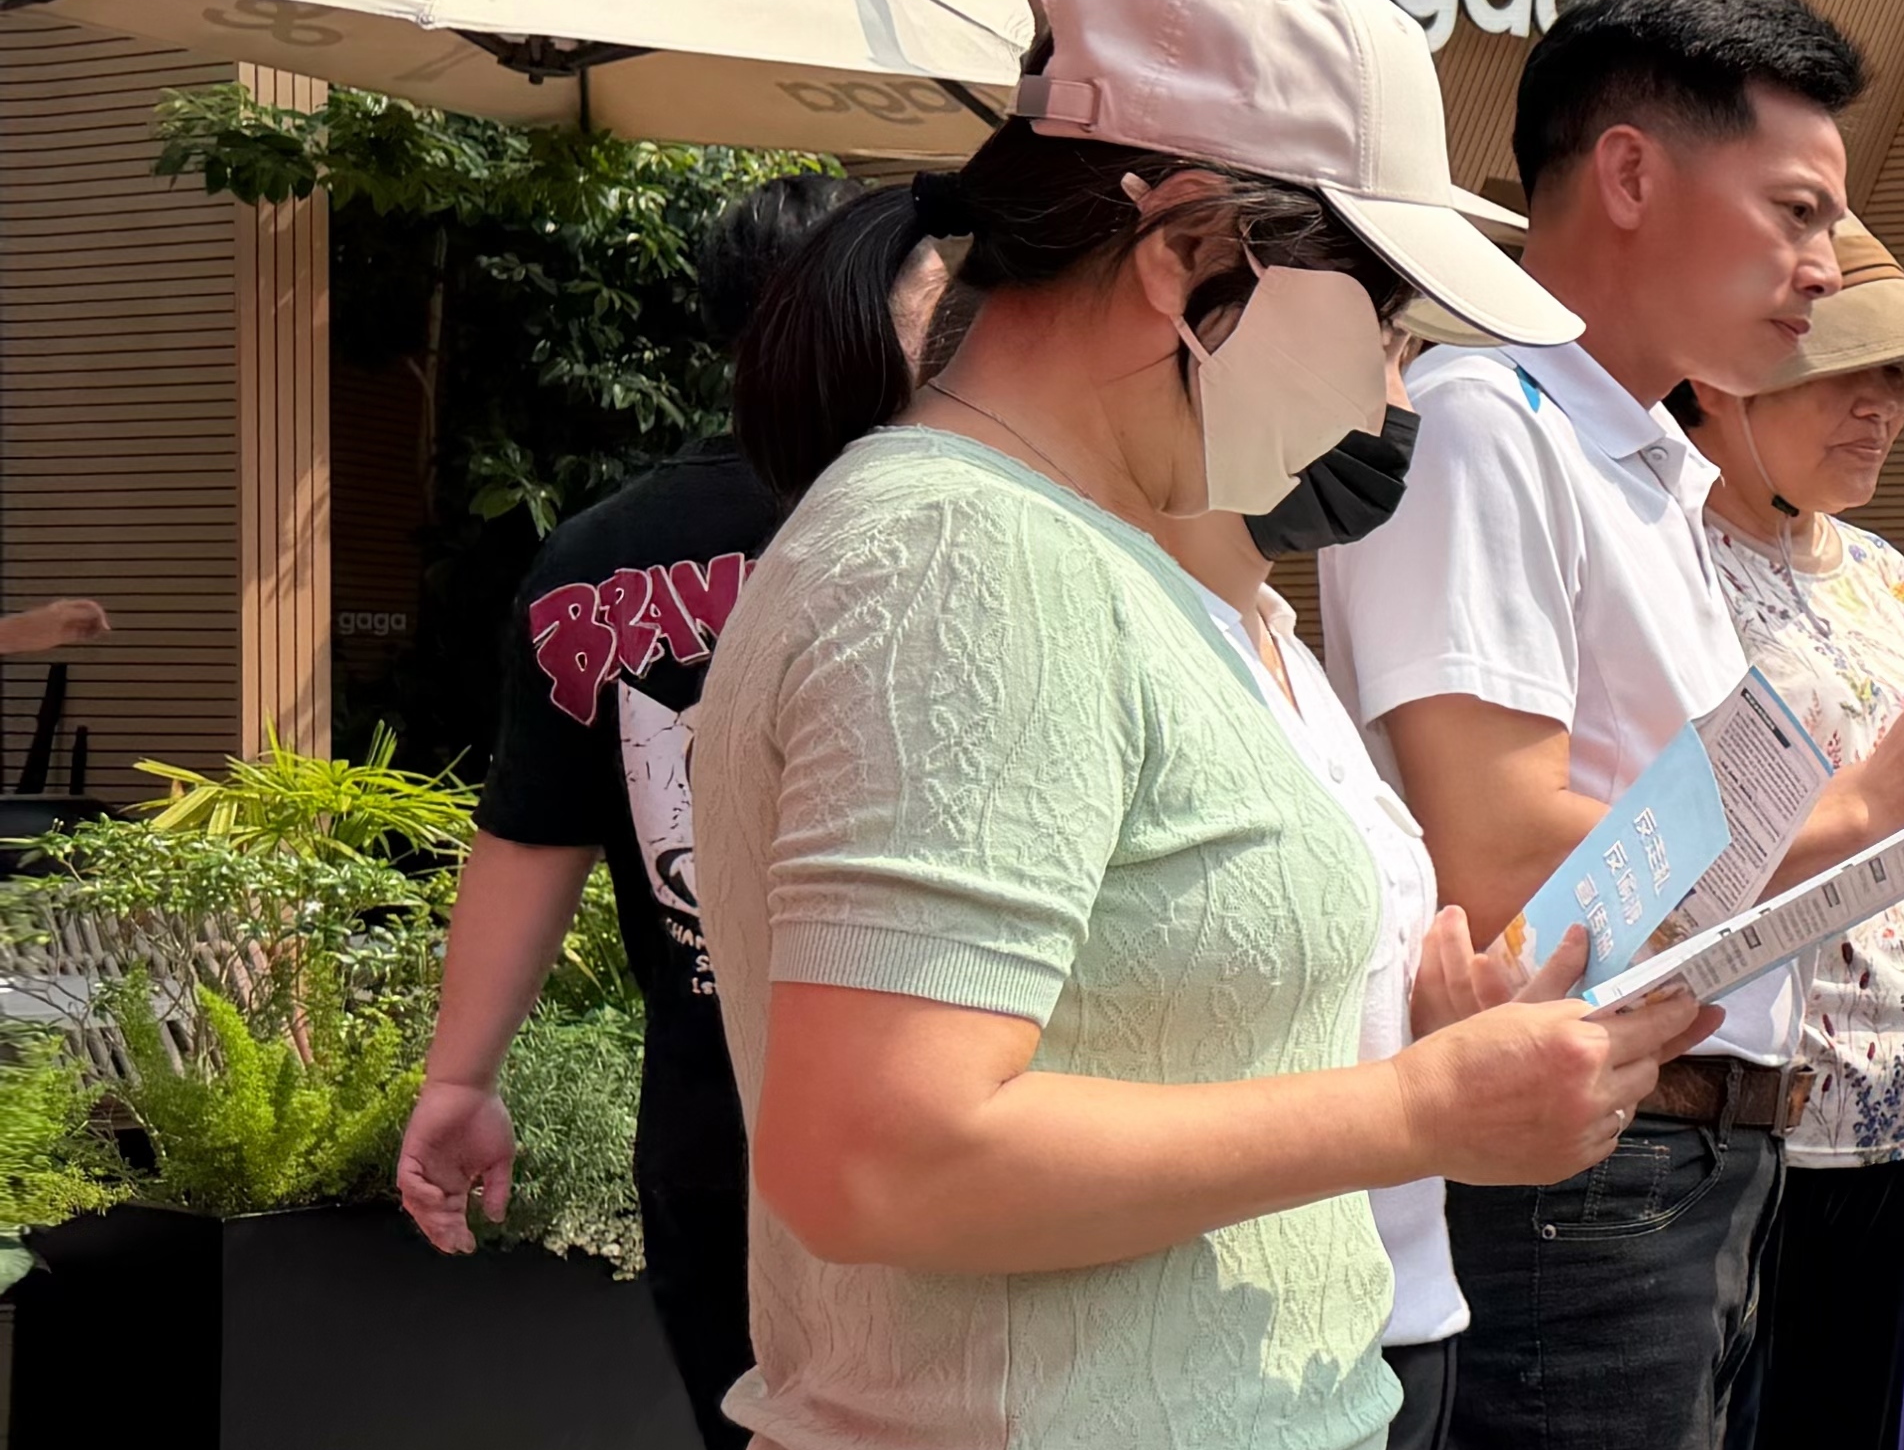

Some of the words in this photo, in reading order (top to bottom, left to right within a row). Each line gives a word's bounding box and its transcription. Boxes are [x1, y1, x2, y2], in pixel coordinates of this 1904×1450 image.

[338, 609, 407, 636] gaga
[1633, 807, 1671, 897] 反走私
